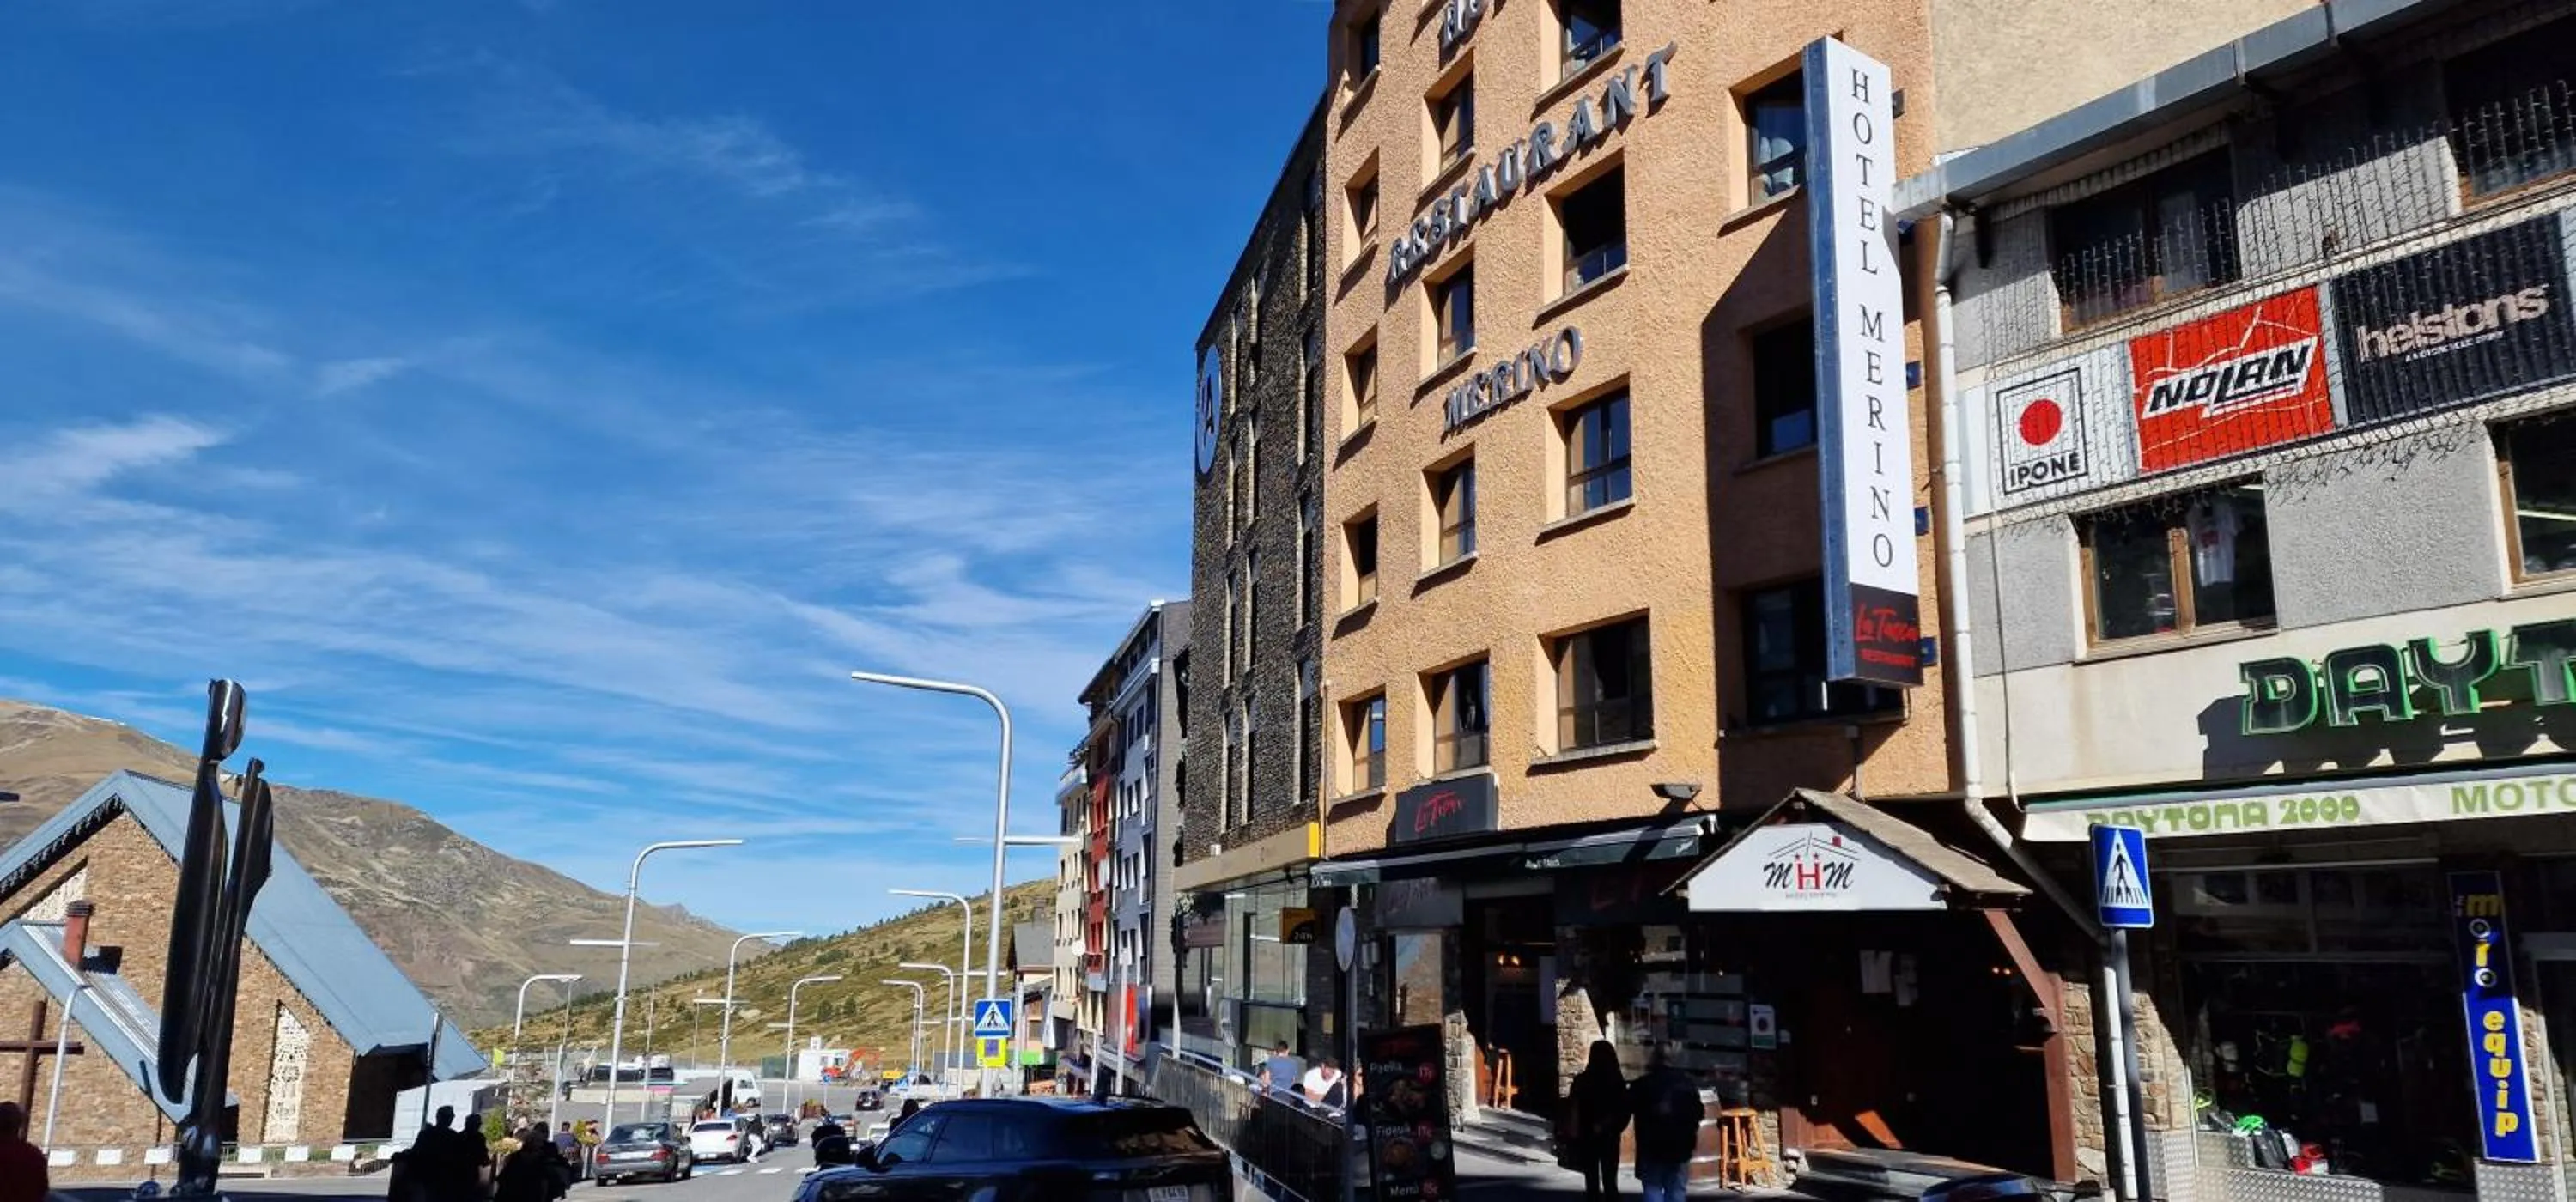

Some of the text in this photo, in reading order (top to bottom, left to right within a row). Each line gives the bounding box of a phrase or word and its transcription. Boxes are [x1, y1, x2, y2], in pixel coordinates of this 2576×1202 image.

[1385, 41, 1677, 285] RESTAURANT
[1851, 68, 1893, 568] HOTEL MERINO
[2356, 284, 2549, 364] helstons
[1444, 325, 1583, 432] MERINO
[2147, 343, 2312, 414] NOLAN
[2008, 452, 2081, 489] IPONE
[2239, 618, 2576, 736] DAYT
[2279, 795, 2360, 825] 2000
[2482, 1011, 2519, 1138] equip
